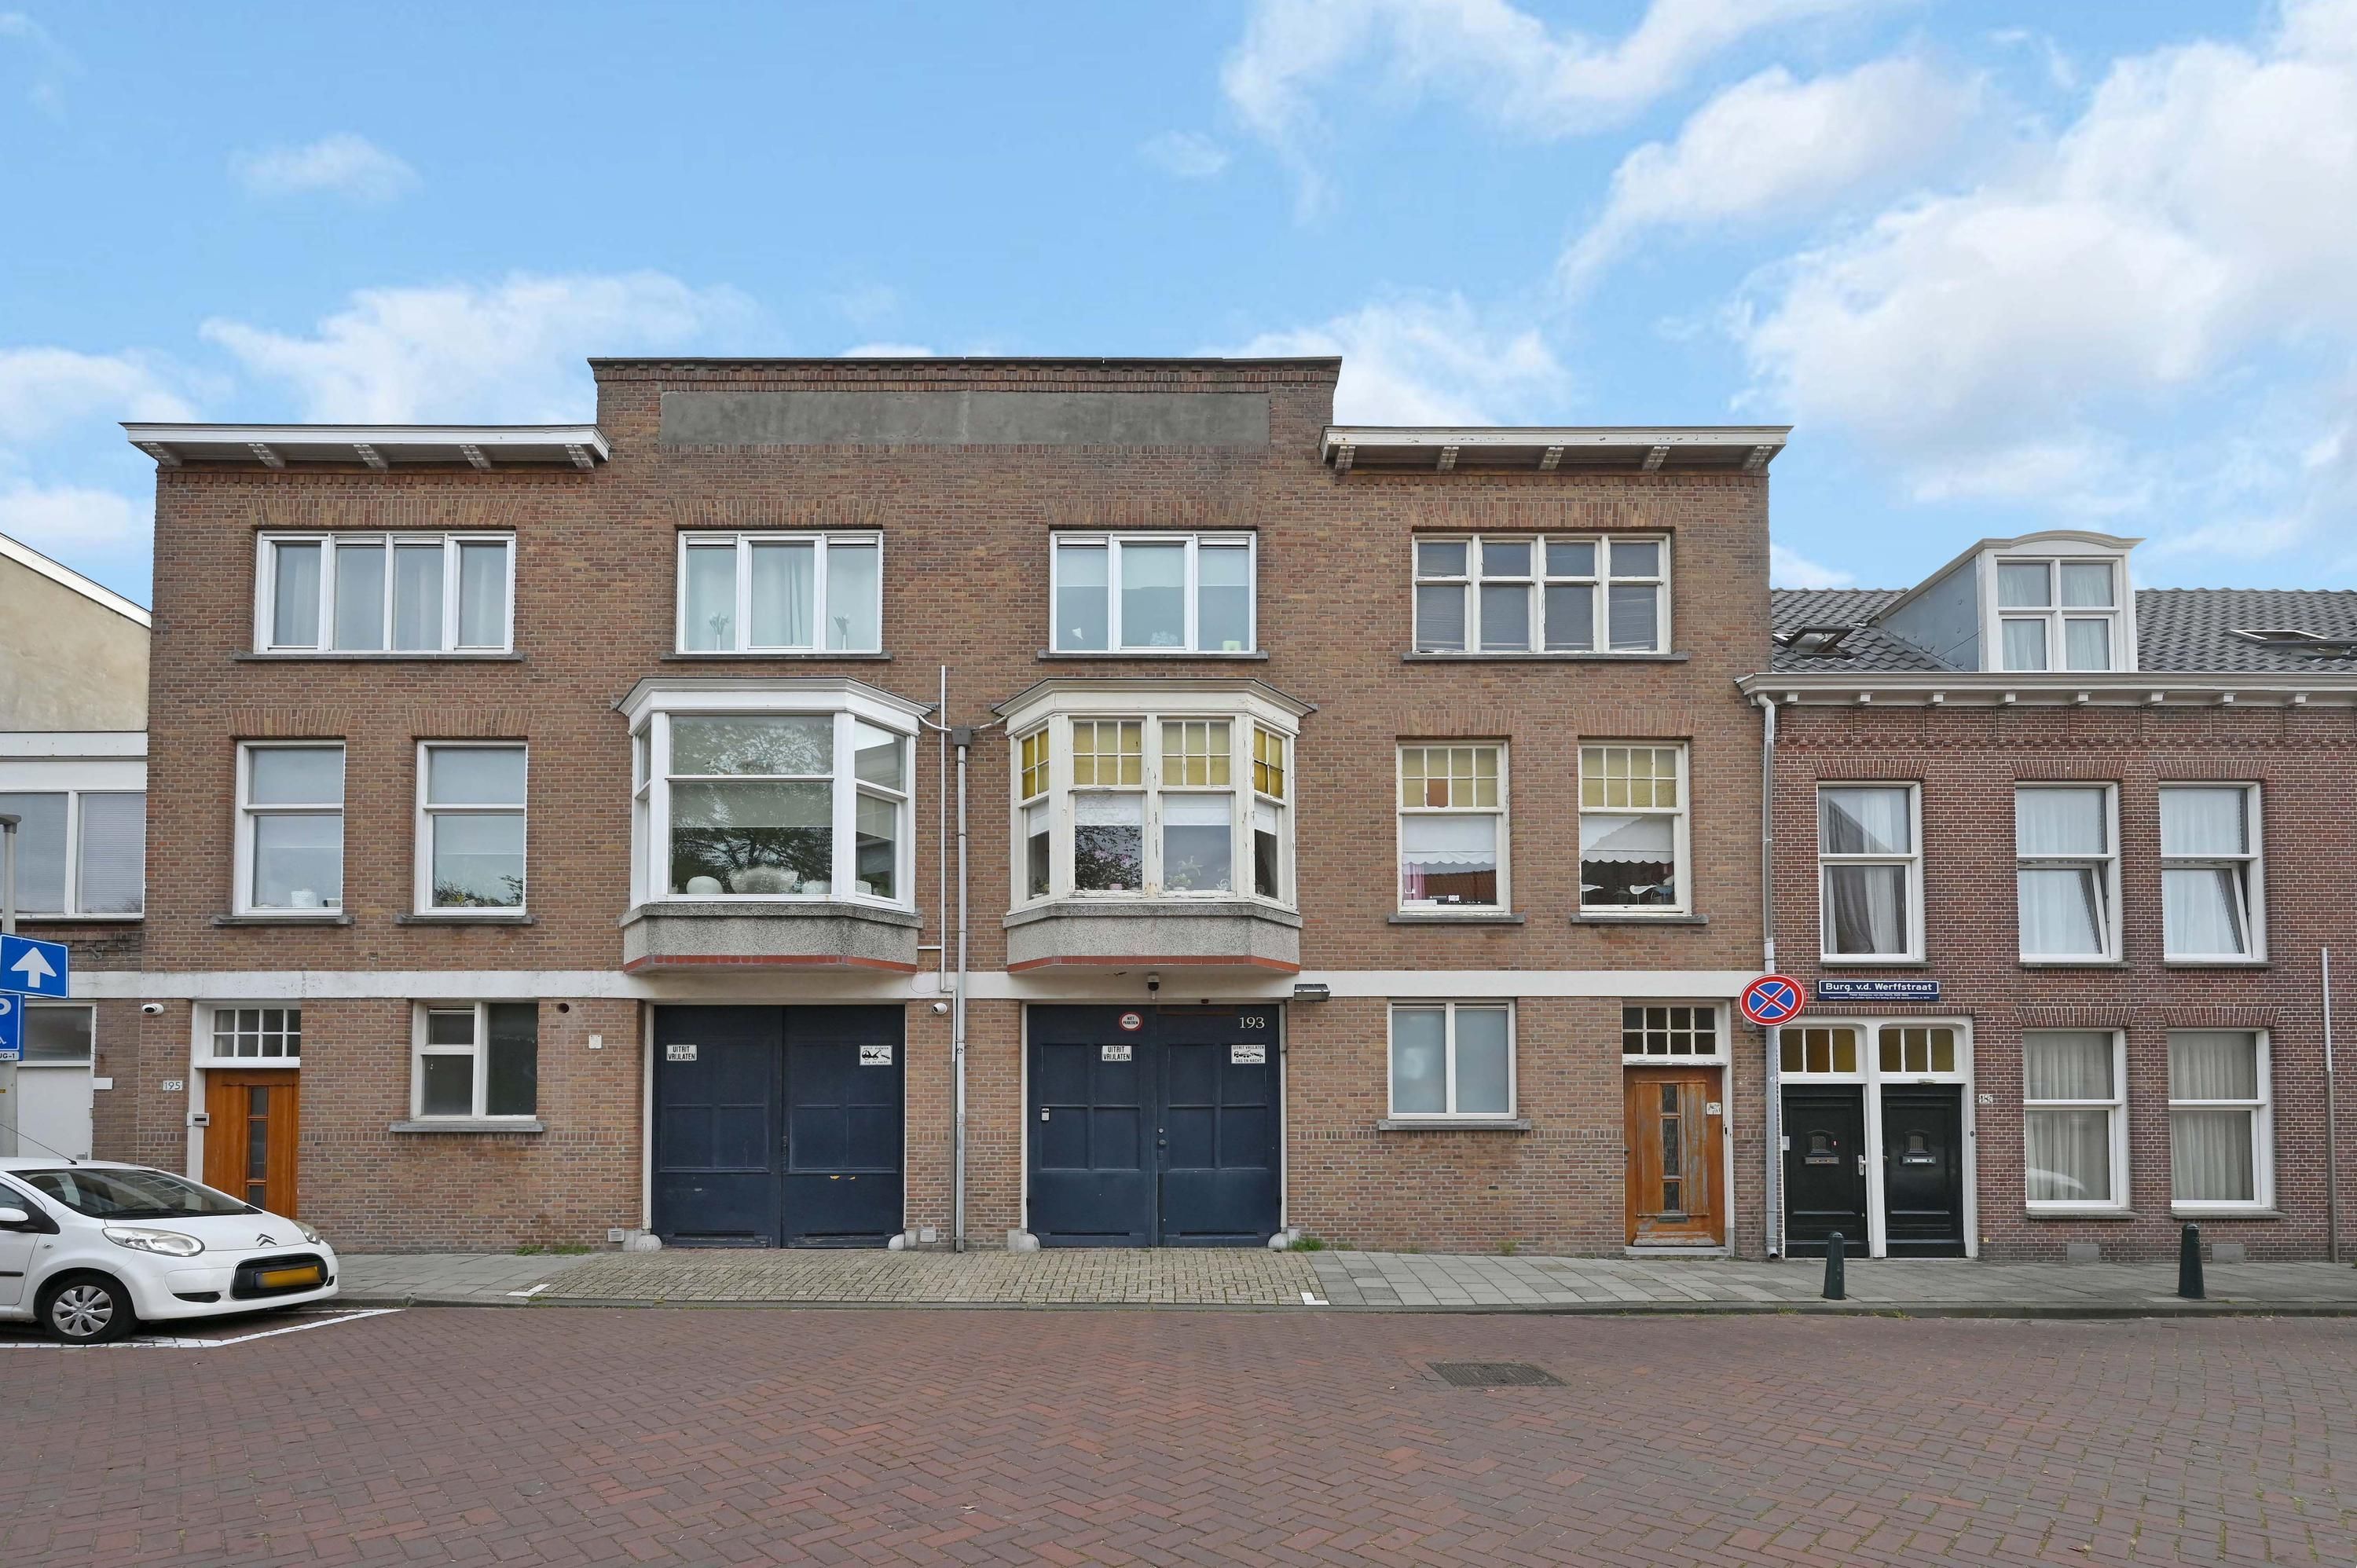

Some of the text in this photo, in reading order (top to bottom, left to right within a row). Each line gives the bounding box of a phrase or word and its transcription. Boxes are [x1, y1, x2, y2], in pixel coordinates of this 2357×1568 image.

[1825, 983, 1853, 992] Burg.
[1239, 1017, 1265, 1029] 193
[165, 1081, 181, 1090] 195
